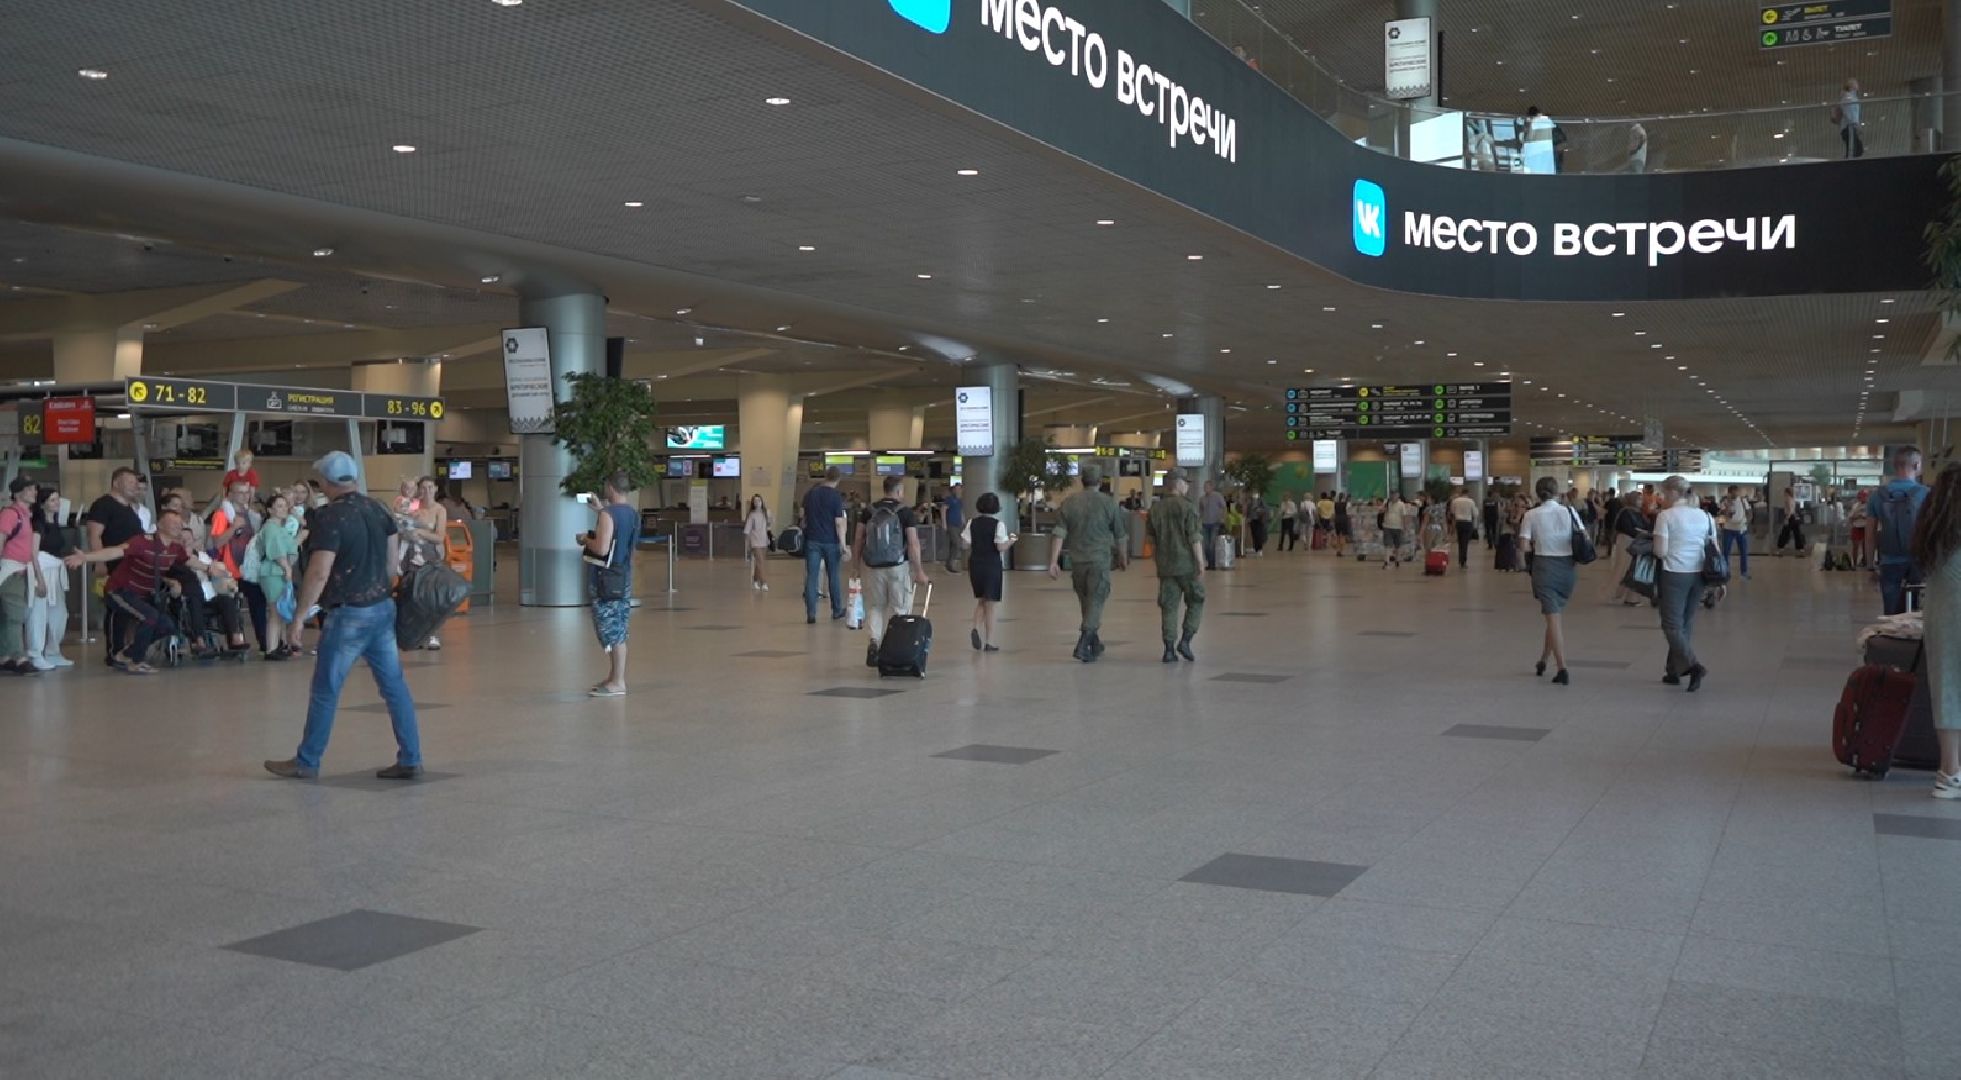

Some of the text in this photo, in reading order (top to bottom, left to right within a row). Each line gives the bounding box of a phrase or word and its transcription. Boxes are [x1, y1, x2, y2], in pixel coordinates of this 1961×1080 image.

[1117, 49, 1236, 163] встречи
[1404, 211, 1796, 267] место встречи
[24, 414, 40, 434] 82
